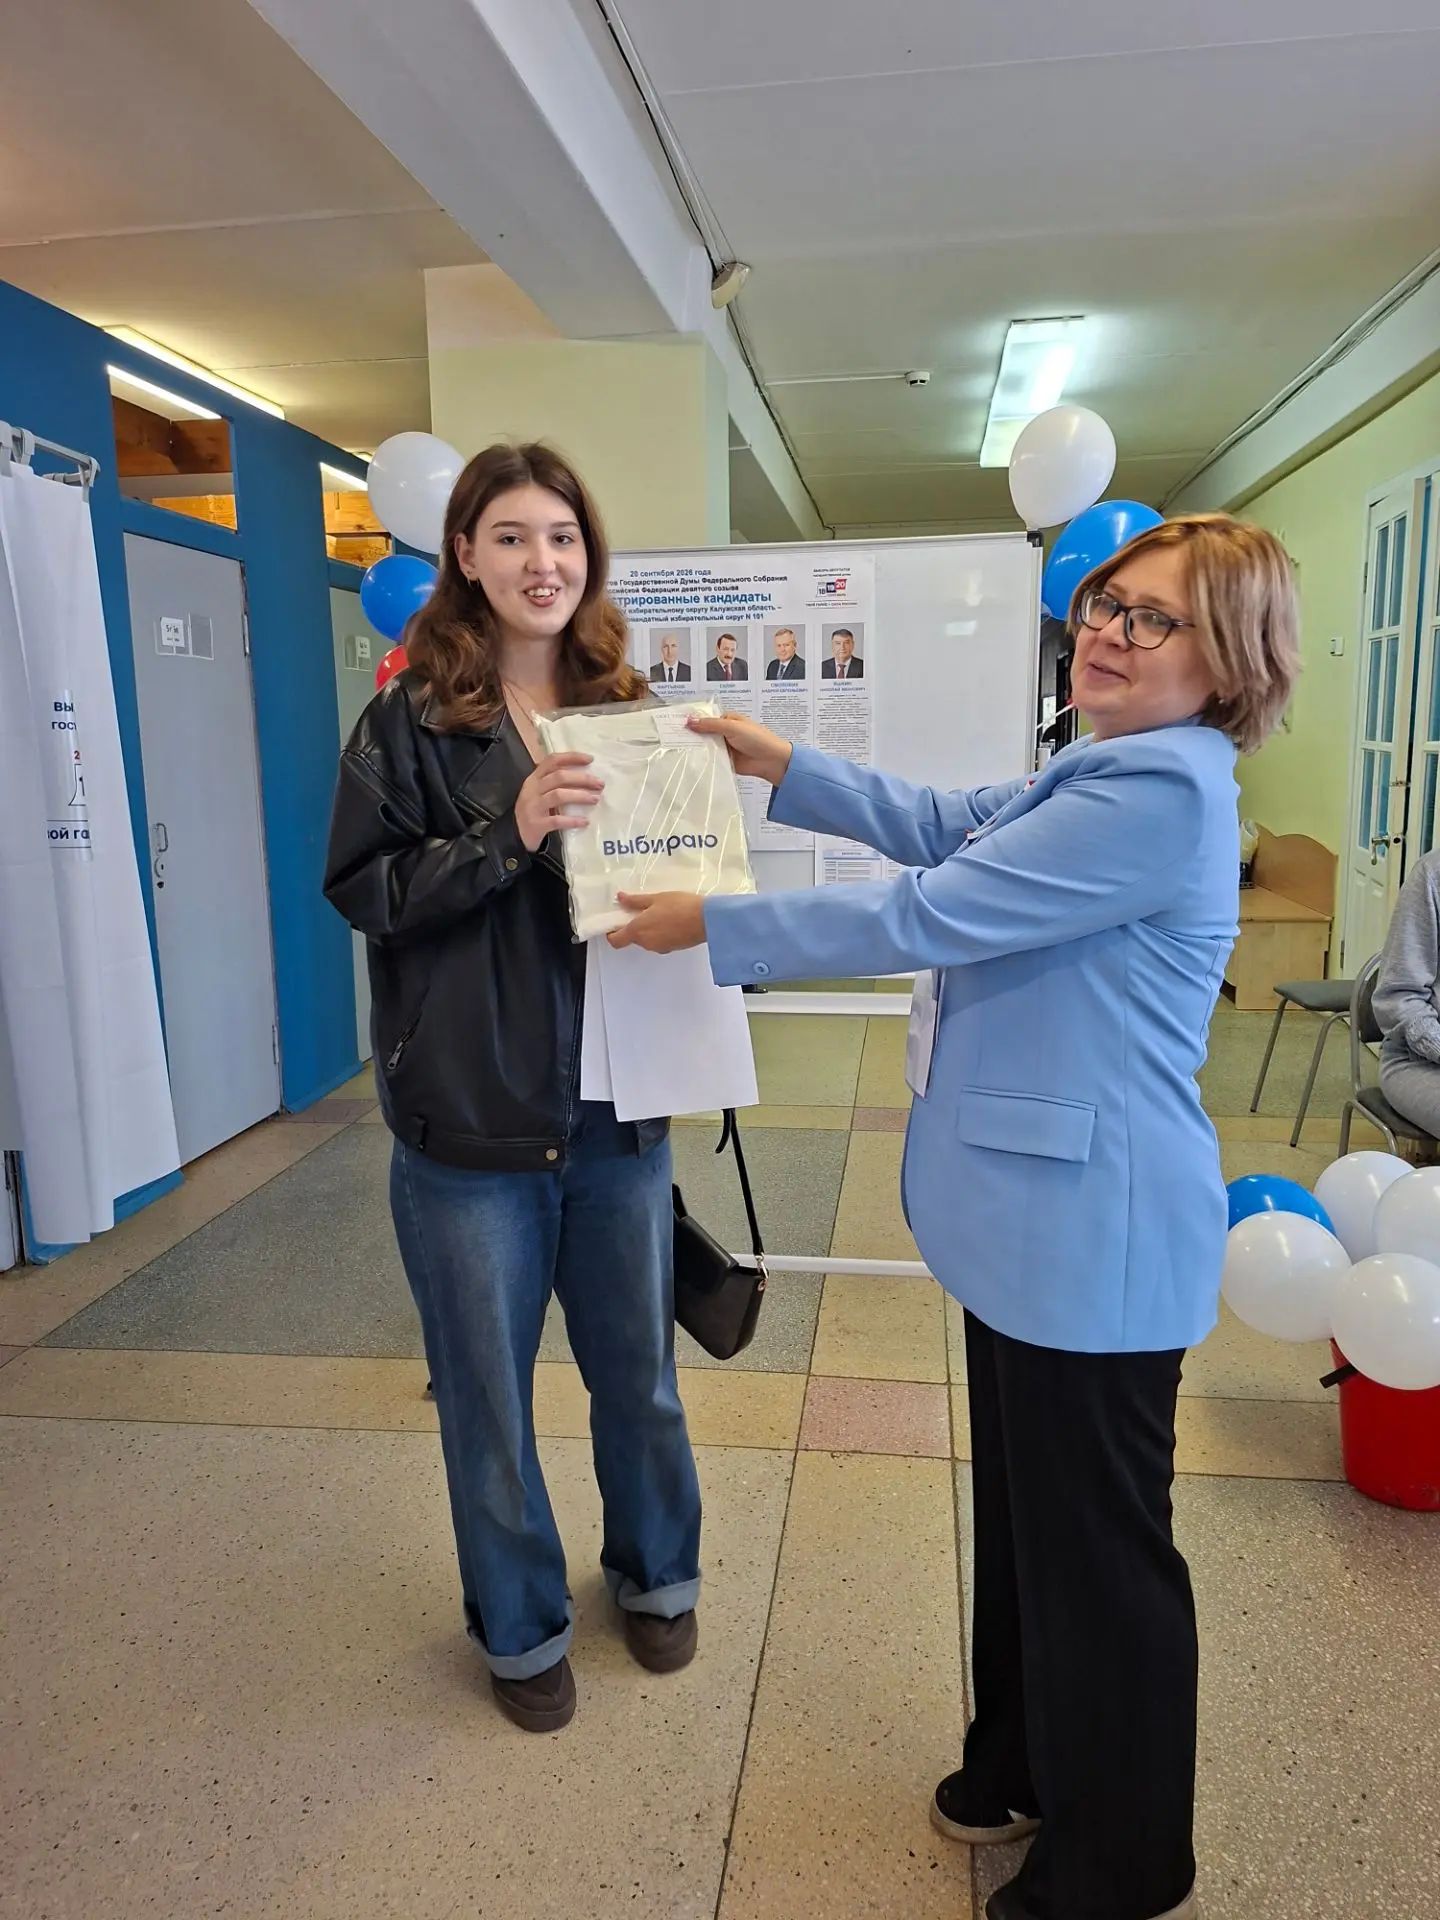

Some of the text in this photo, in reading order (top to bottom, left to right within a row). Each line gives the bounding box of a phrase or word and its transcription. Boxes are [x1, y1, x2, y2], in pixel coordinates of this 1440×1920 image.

[640, 570, 675, 578] сентября
[619, 578, 679, 587] Государственной
[680, 577, 700, 586] Думы
[701, 576, 752, 585] Федерального
[752, 575, 788, 583] Собрания
[641, 586, 680, 594] Федерации
[681, 585, 712, 593] девятого
[703, 593, 772, 605] кандидаты
[628, 607, 684, 615] избирательному
[685, 606, 708, 614] округу
[709, 605, 746, 613] Калужская
[670, 613, 724, 622] избирательный
[48, 827, 70, 840] ОЙ
[603, 834, 719, 857] выбираю
